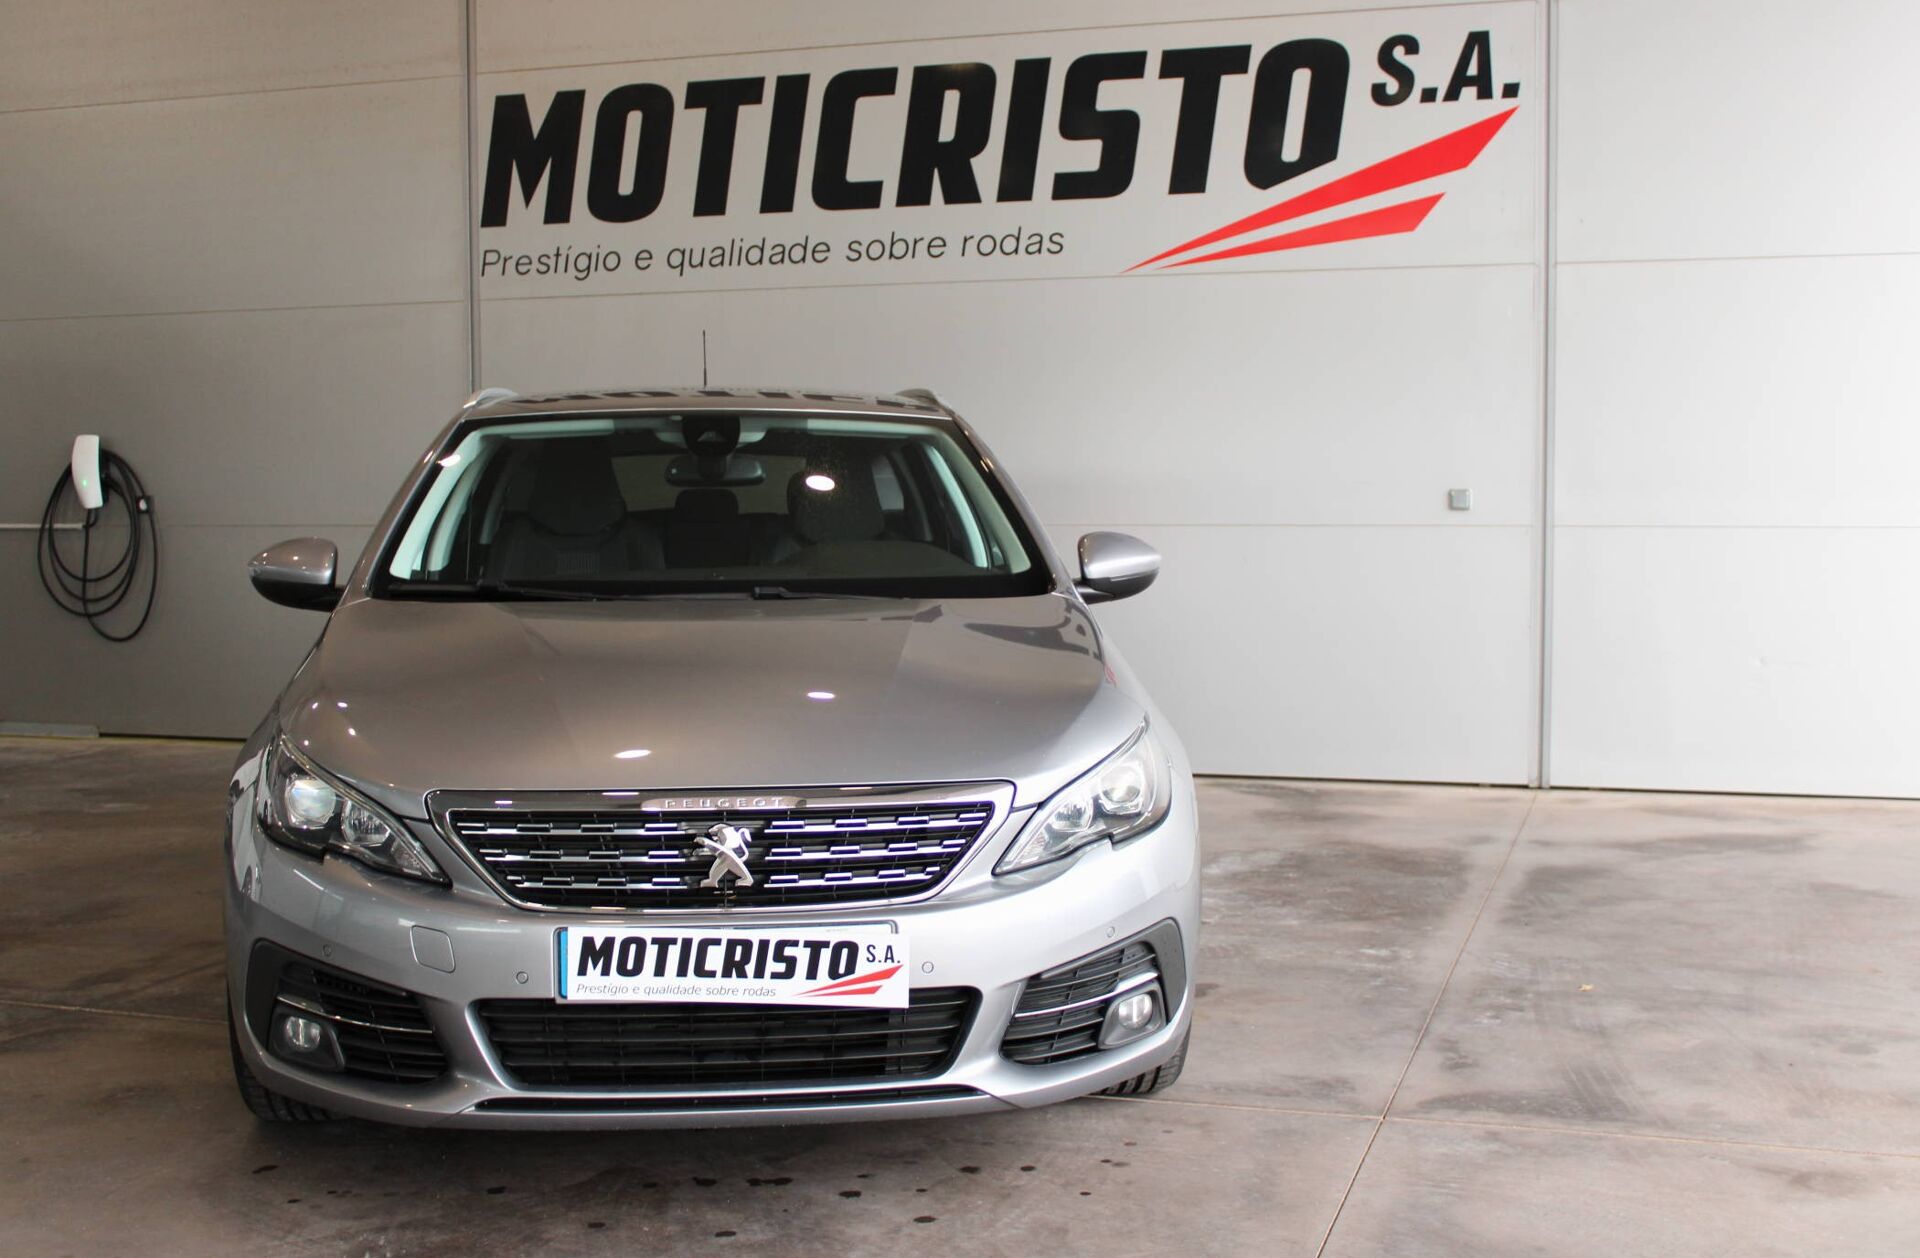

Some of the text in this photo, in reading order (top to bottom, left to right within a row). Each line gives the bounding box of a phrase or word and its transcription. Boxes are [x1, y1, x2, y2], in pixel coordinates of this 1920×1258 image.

[480, 30, 1521, 228] MOTICRISTO S.A.
[481, 226, 1065, 281] Prestígio e qualidade sobre rodas
[665, 797, 783, 808] PEUGEOT
[577, 936, 901, 981] MOTICRISTO S.A.
[576, 983, 777, 996] Prestígio e qualidade sobre rodas
